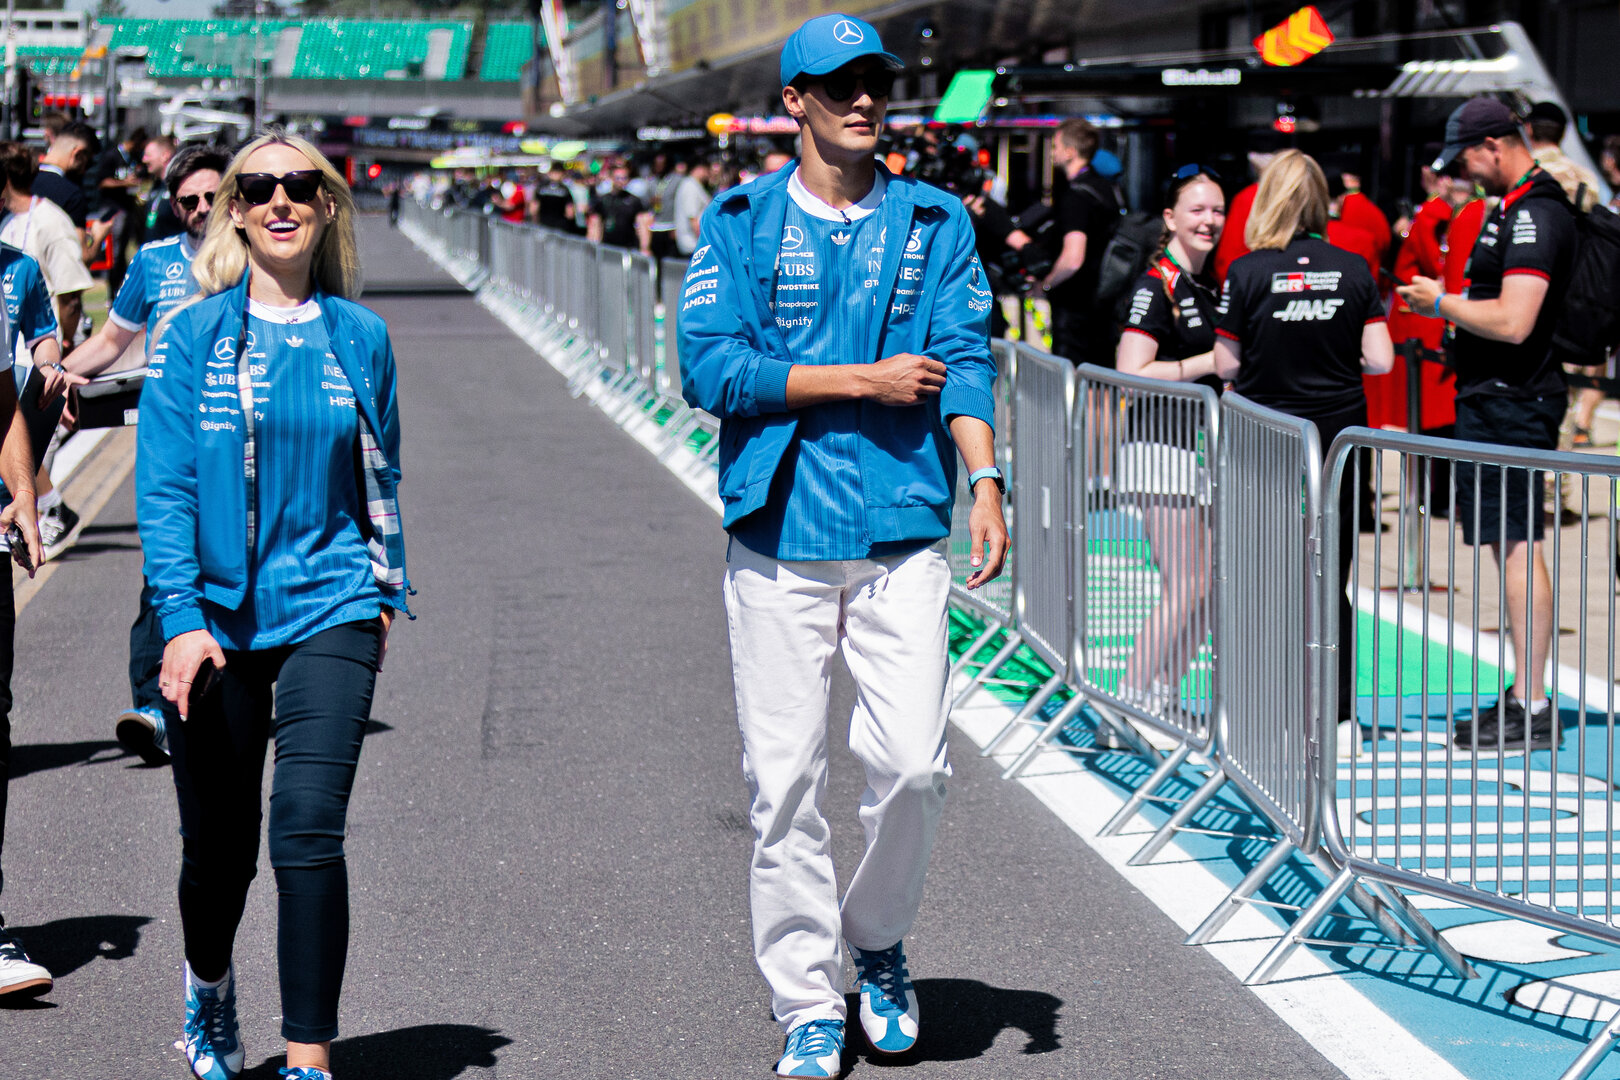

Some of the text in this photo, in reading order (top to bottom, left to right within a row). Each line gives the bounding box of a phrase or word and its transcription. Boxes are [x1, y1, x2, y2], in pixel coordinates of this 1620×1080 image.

[784, 263, 815, 276] UBS
[777, 283, 820, 291] OWDSTRIKE
[682, 295, 706, 312] AMD
[778, 300, 819, 309] Snapdragon
[249, 364, 267, 376] BS
[323, 364, 347, 379] INE
[218, 373, 236, 386] UB
[329, 395, 357, 409] HPE
